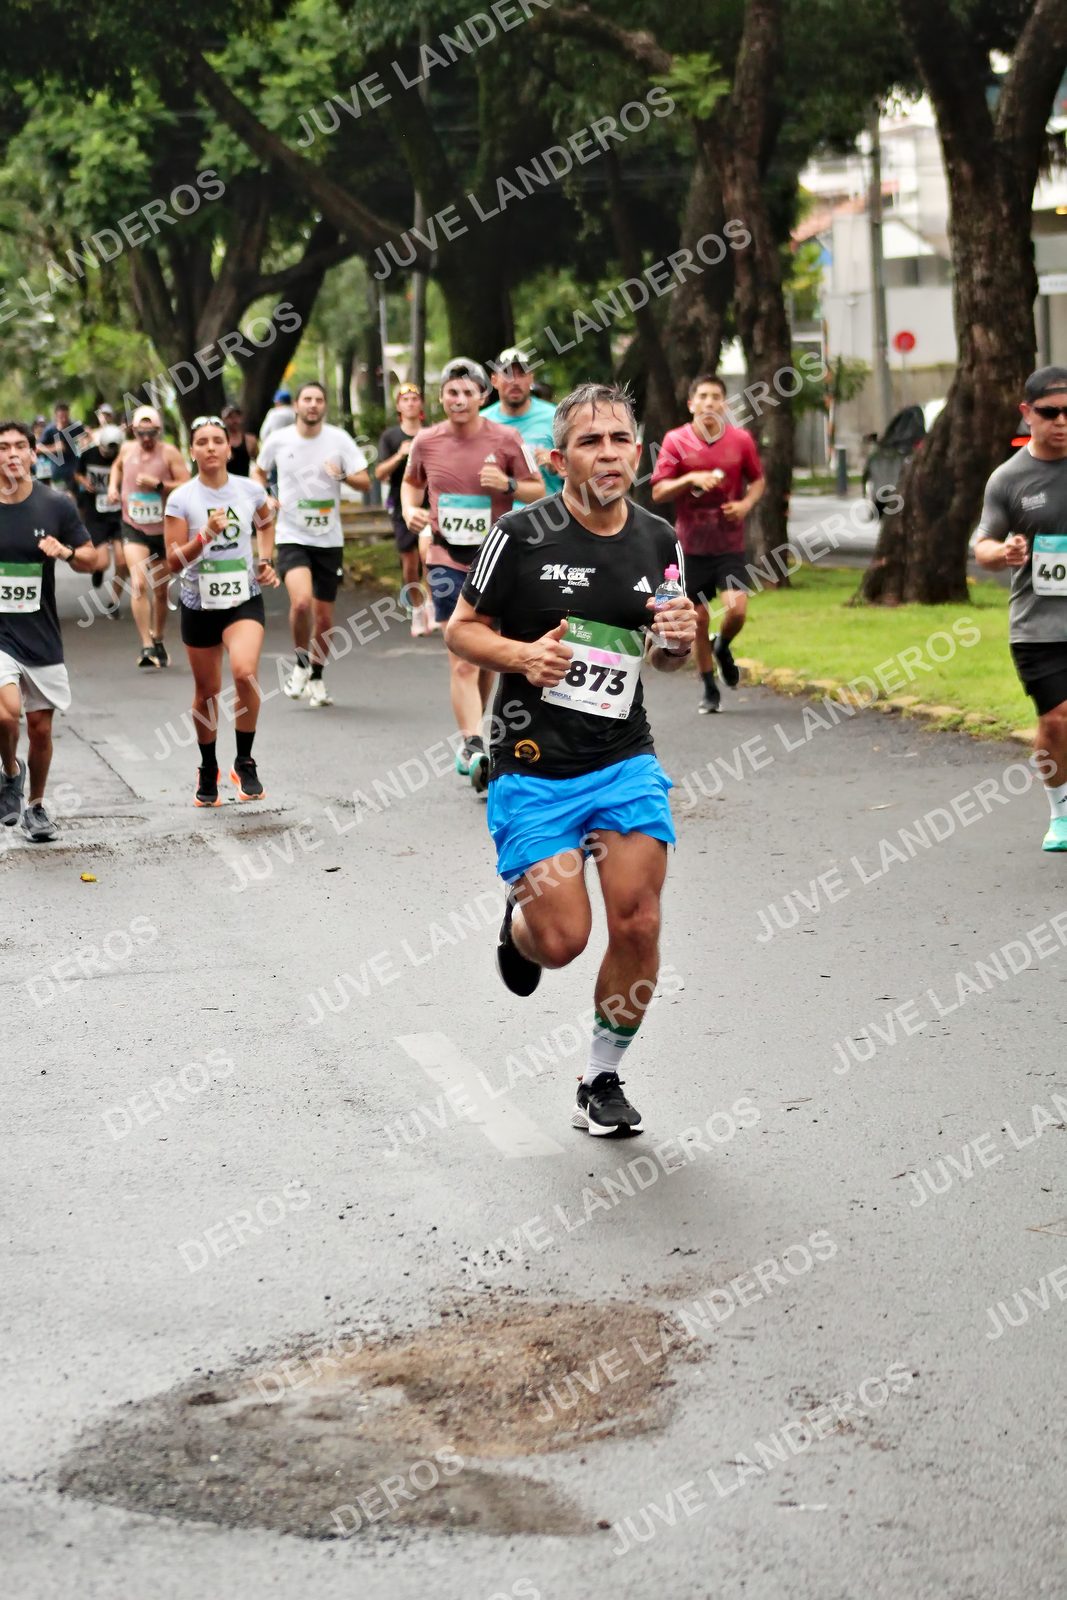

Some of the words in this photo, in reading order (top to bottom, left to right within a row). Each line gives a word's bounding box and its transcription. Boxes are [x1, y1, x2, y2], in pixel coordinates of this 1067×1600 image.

[304, 515, 329, 527] 733
[442, 517, 486, 532] 4748
[1037, 563, 1066, 581] 40
[1, 586, 37, 600] 395
[209, 581, 242, 596] 823
[565, 660, 627, 696] 873
